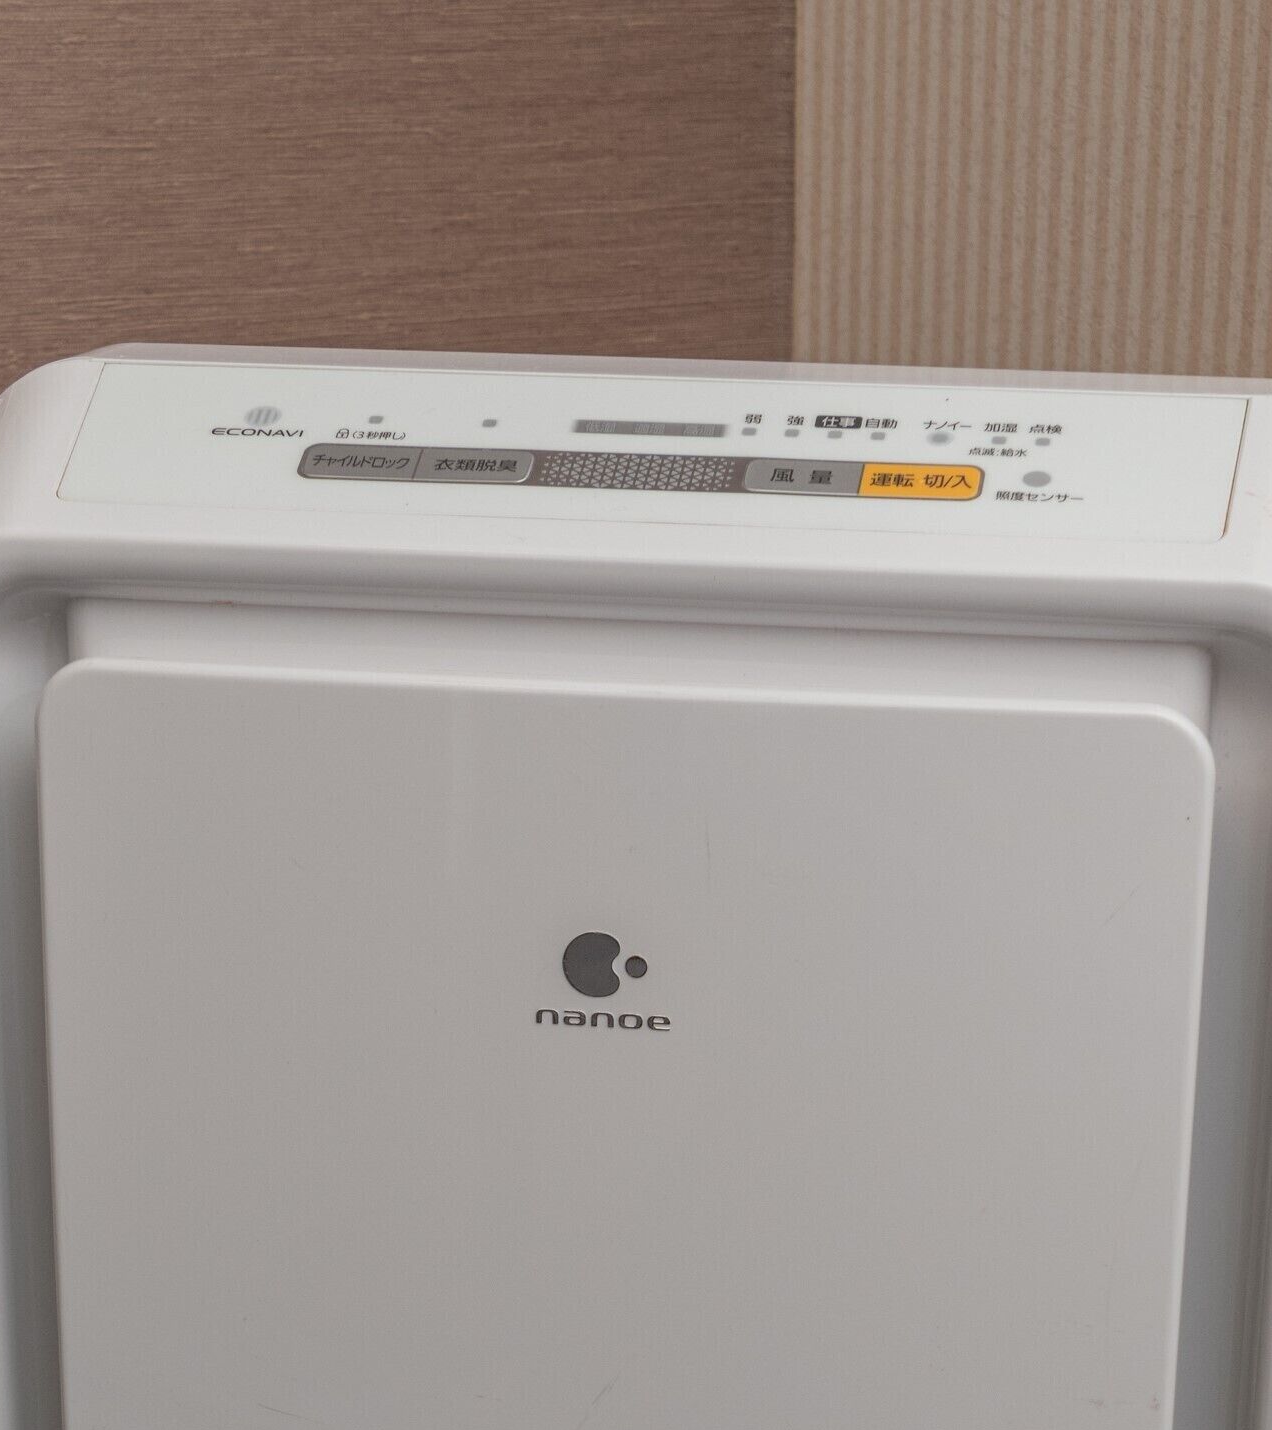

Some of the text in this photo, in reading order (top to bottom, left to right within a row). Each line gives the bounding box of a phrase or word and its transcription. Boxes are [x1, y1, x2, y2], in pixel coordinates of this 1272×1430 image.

[745, 413, 763, 424] 弱
[786, 415, 805, 426] 強
[822, 416, 856, 428] 仕事
[865, 418, 898, 429] 自動
[923, 420, 972, 431] ナノイー
[984, 422, 1018, 433] 加湿
[1029, 423, 1062, 434] 点検
[211, 427, 304, 438] ECONAVI
[312, 454, 410, 469] チャイルドロック
[434, 458, 518, 473] 衣類脱臭
[870, 472, 972, 489] 運転 切/入
[995, 491, 1084, 502] 照度センサー
[535, 1008, 671, 1031] nanoe
